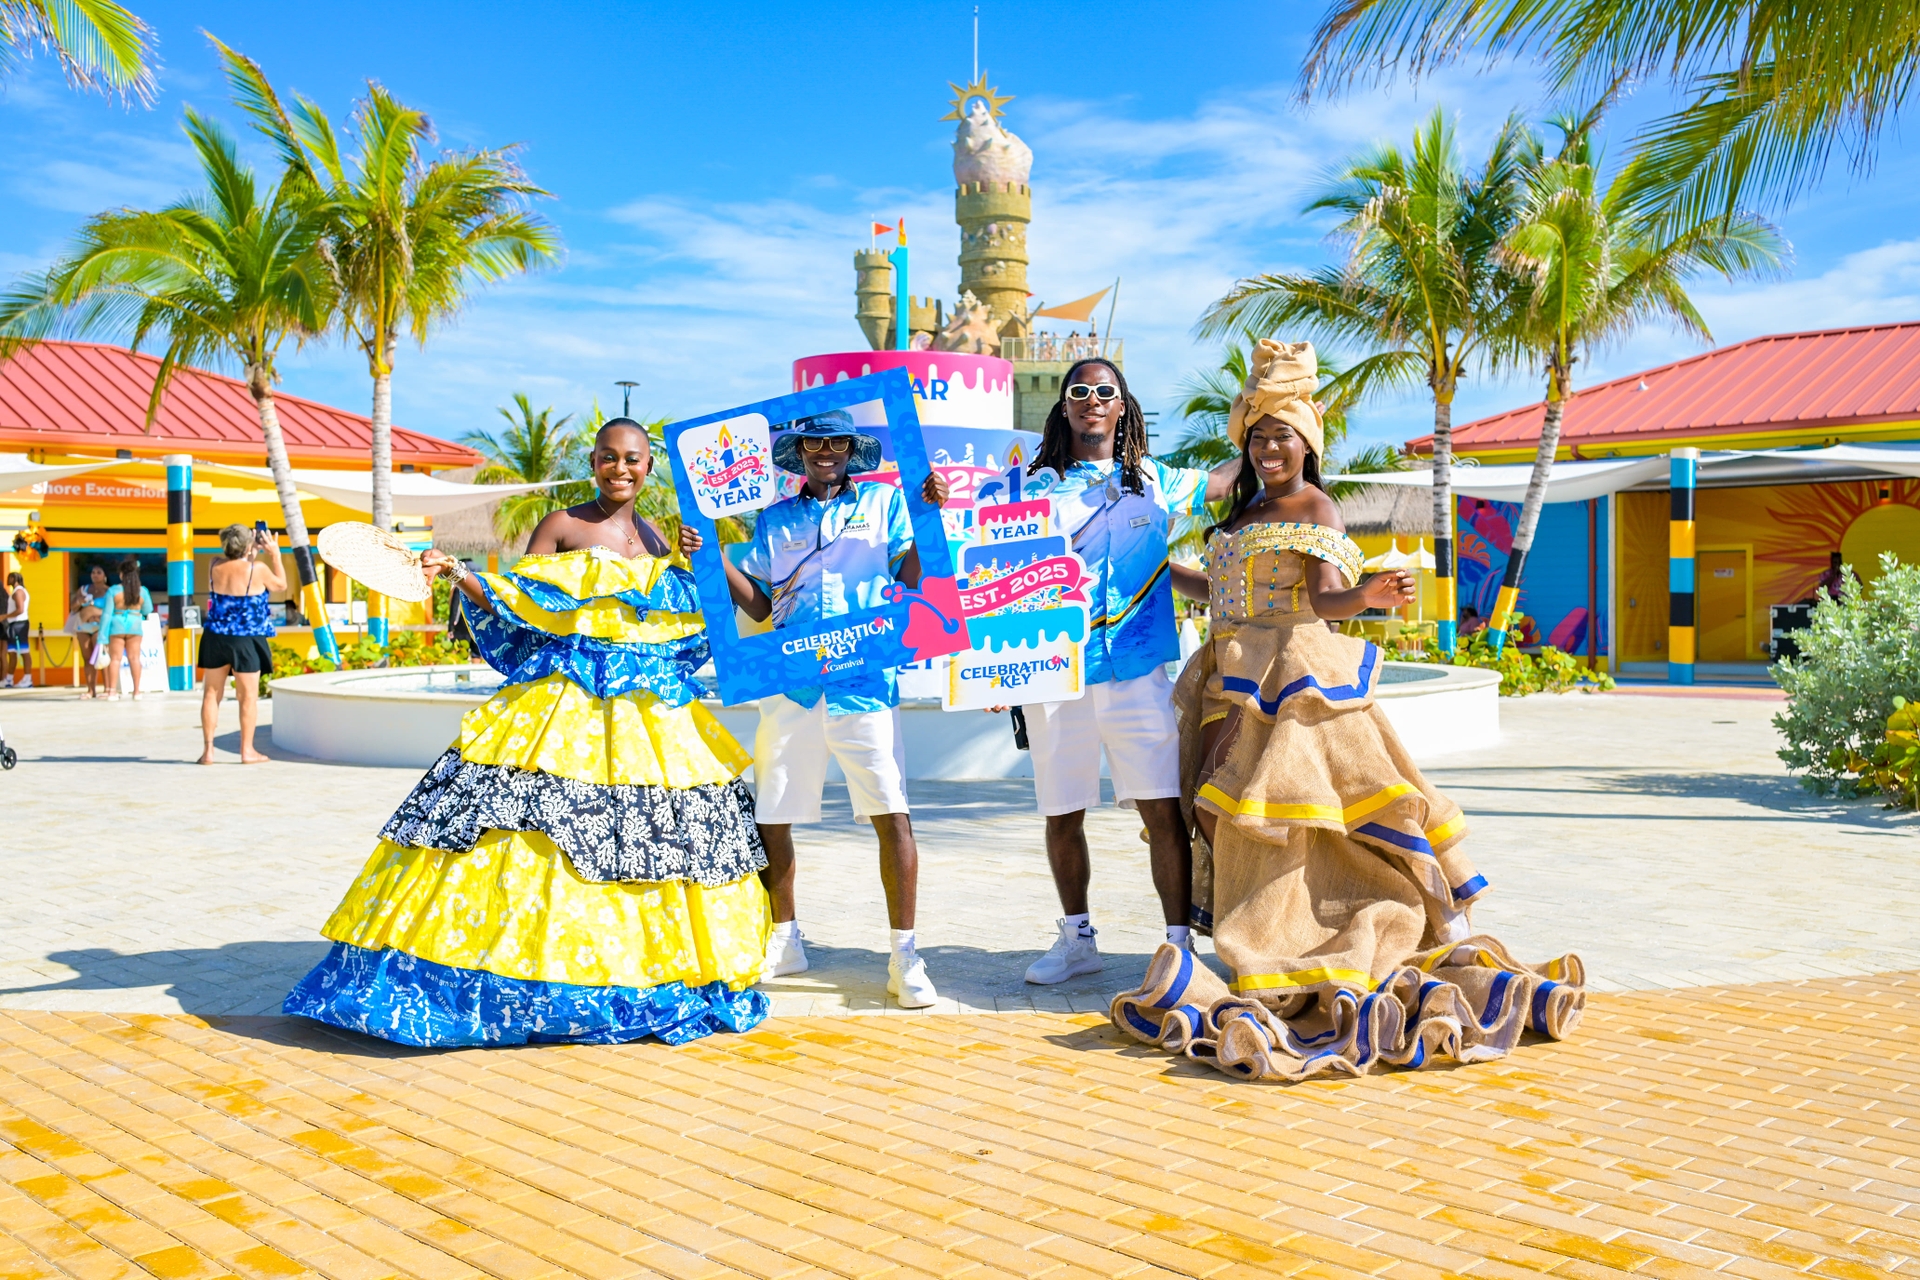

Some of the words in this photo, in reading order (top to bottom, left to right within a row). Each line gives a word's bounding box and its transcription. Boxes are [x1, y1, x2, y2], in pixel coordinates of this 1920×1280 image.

[911, 378, 949, 400] AR
[711, 472, 731, 485] EST.
[731, 458, 755, 475] 2025
[31, 481, 82, 495] Shore
[85, 482, 167, 499] Excursion
[710, 486, 762, 508] YEAR
[991, 523, 1039, 540] YEAR
[960, 587, 1006, 610] EST.
[1009, 563, 1068, 594] 2025
[781, 617, 895, 655] CELEBRATION
[826, 639, 858, 659] KEY
[829, 657, 865, 672] Carnival
[960, 657, 1069, 680] CELEBRATION
[1000, 673, 1031, 689] KEY
[425, 971, 458, 988] bahamas
[435, 990, 460, 1021] bahamas
